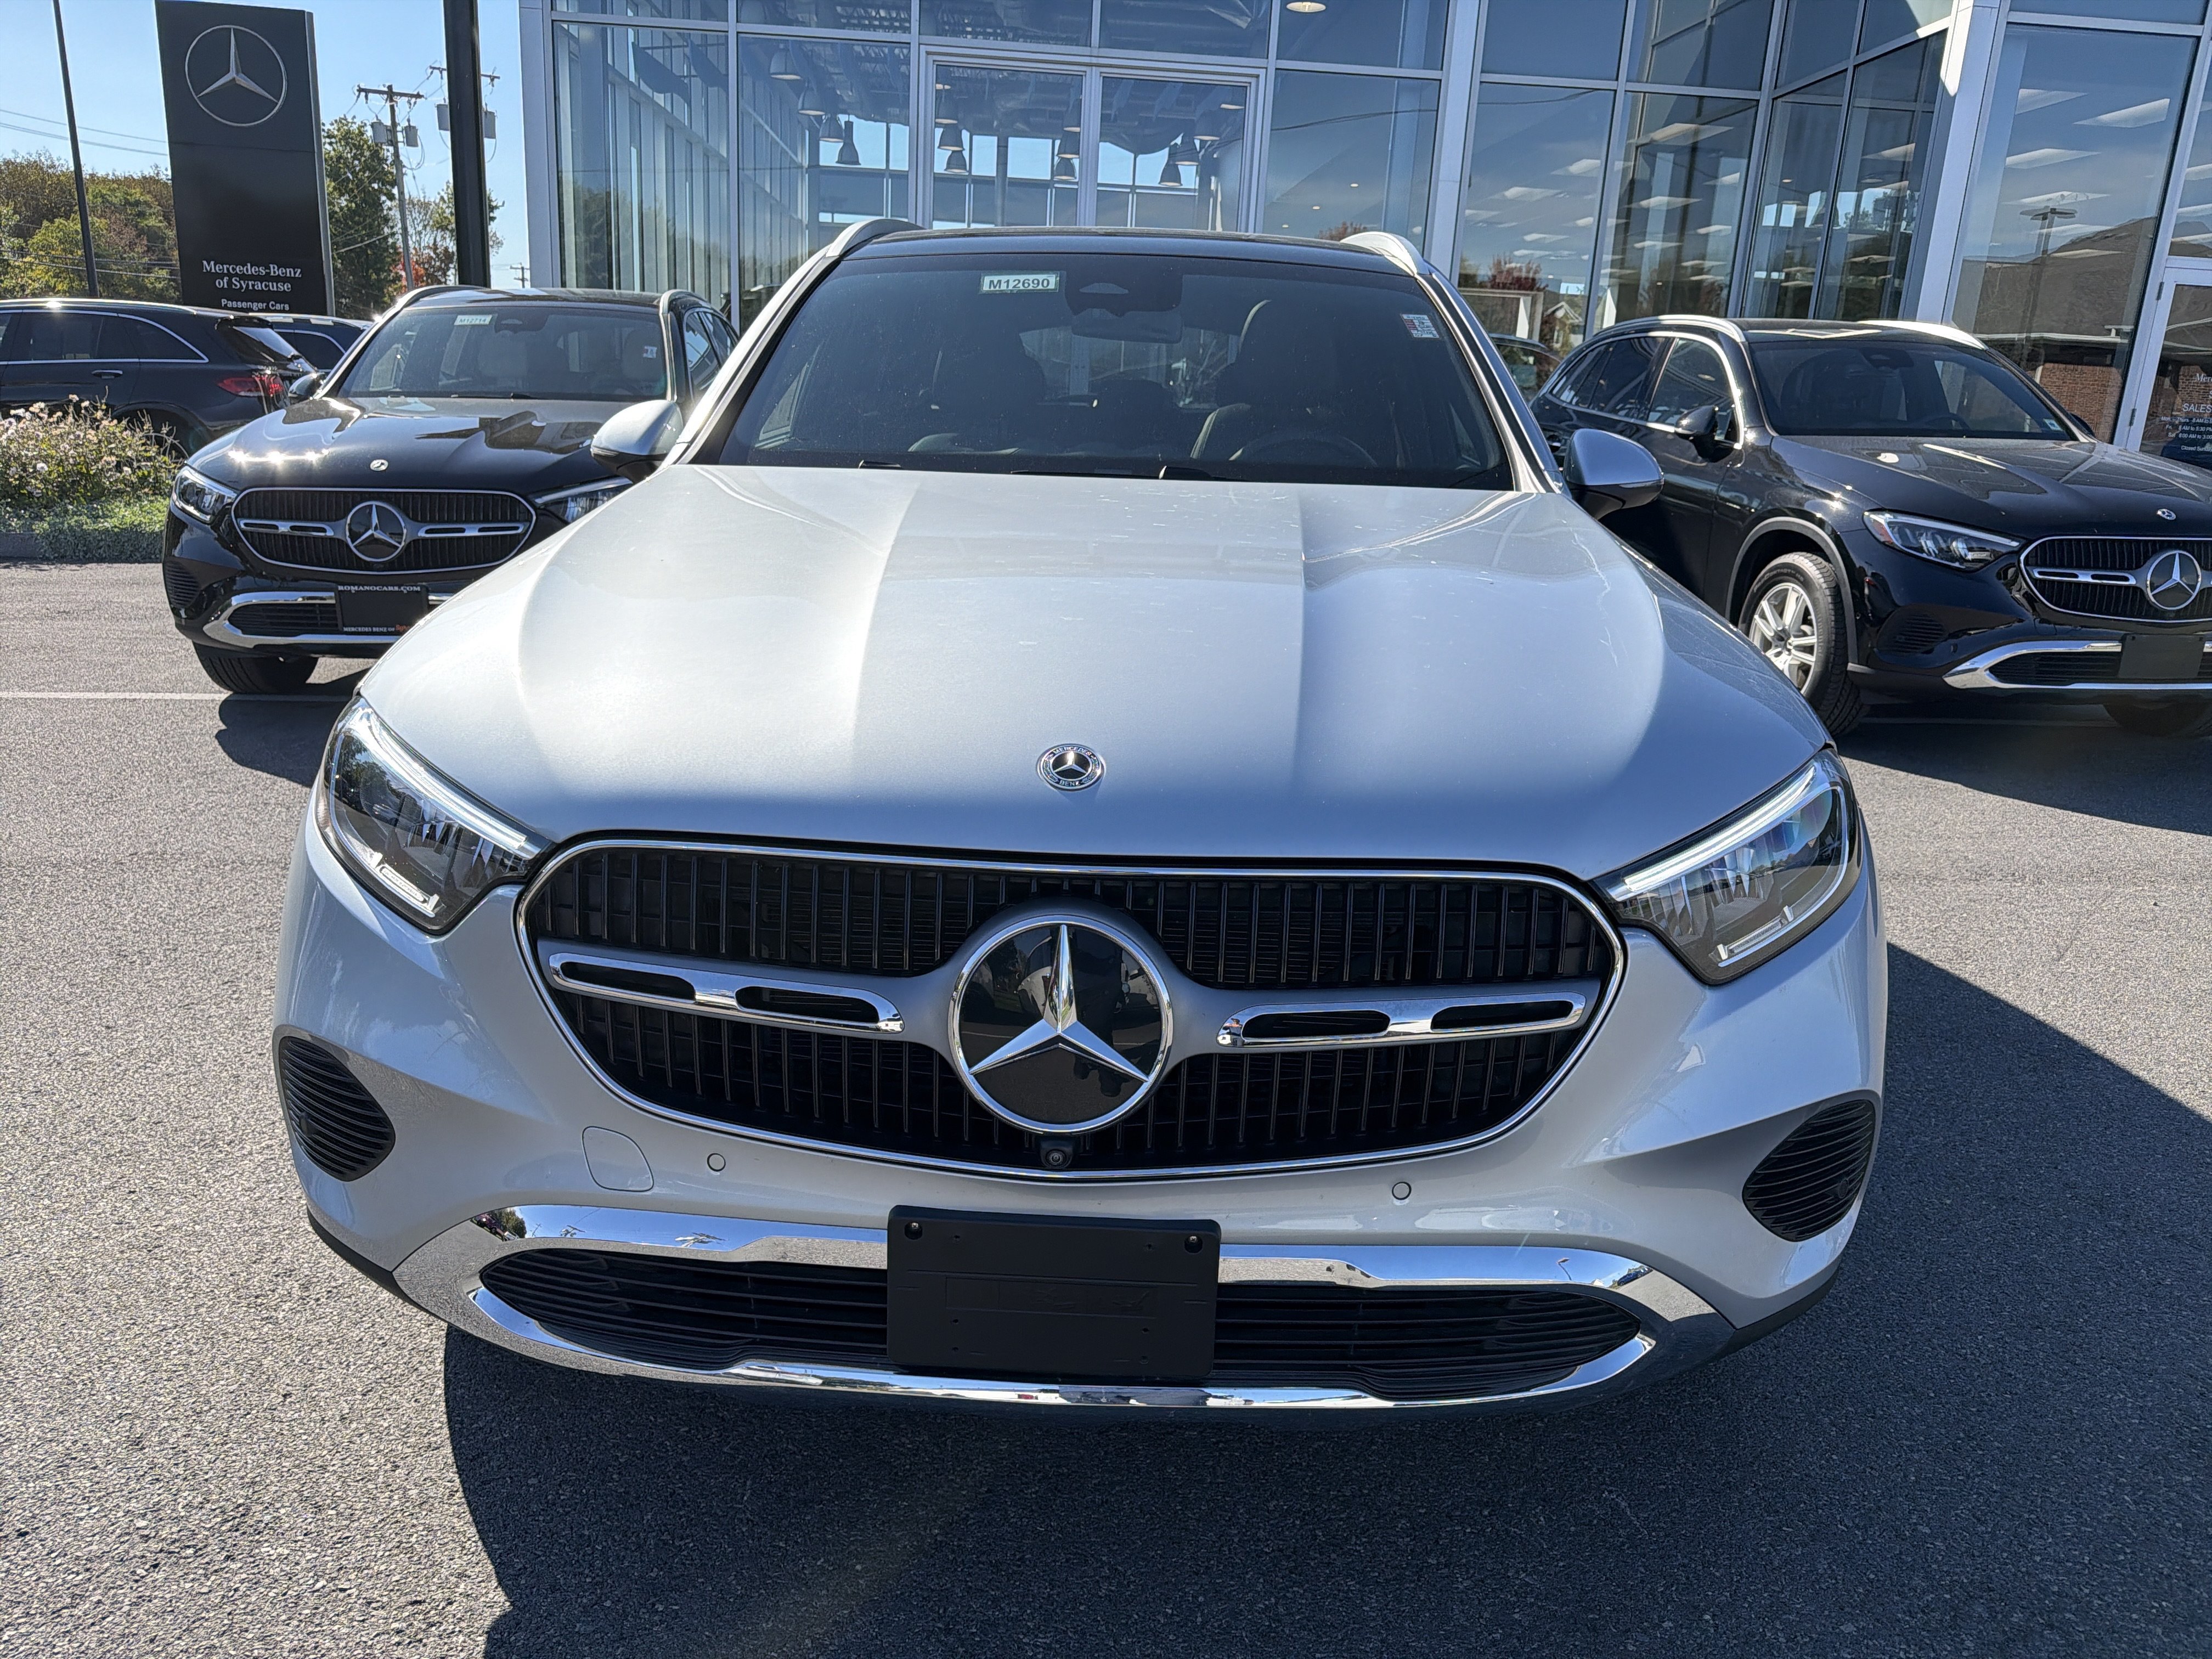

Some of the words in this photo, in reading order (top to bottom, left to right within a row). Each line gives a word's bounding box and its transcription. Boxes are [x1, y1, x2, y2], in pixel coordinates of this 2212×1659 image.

[202, 260, 302, 278] Mercedes-Benz
[216, 276, 229, 289] of
[232, 277, 291, 292] Syracuse
[989, 278, 1050, 289] M12690
[221, 298, 267, 311] Passenger
[269, 301, 290, 311] Cars
[1053, 747, 1092, 755] MERCEDES
